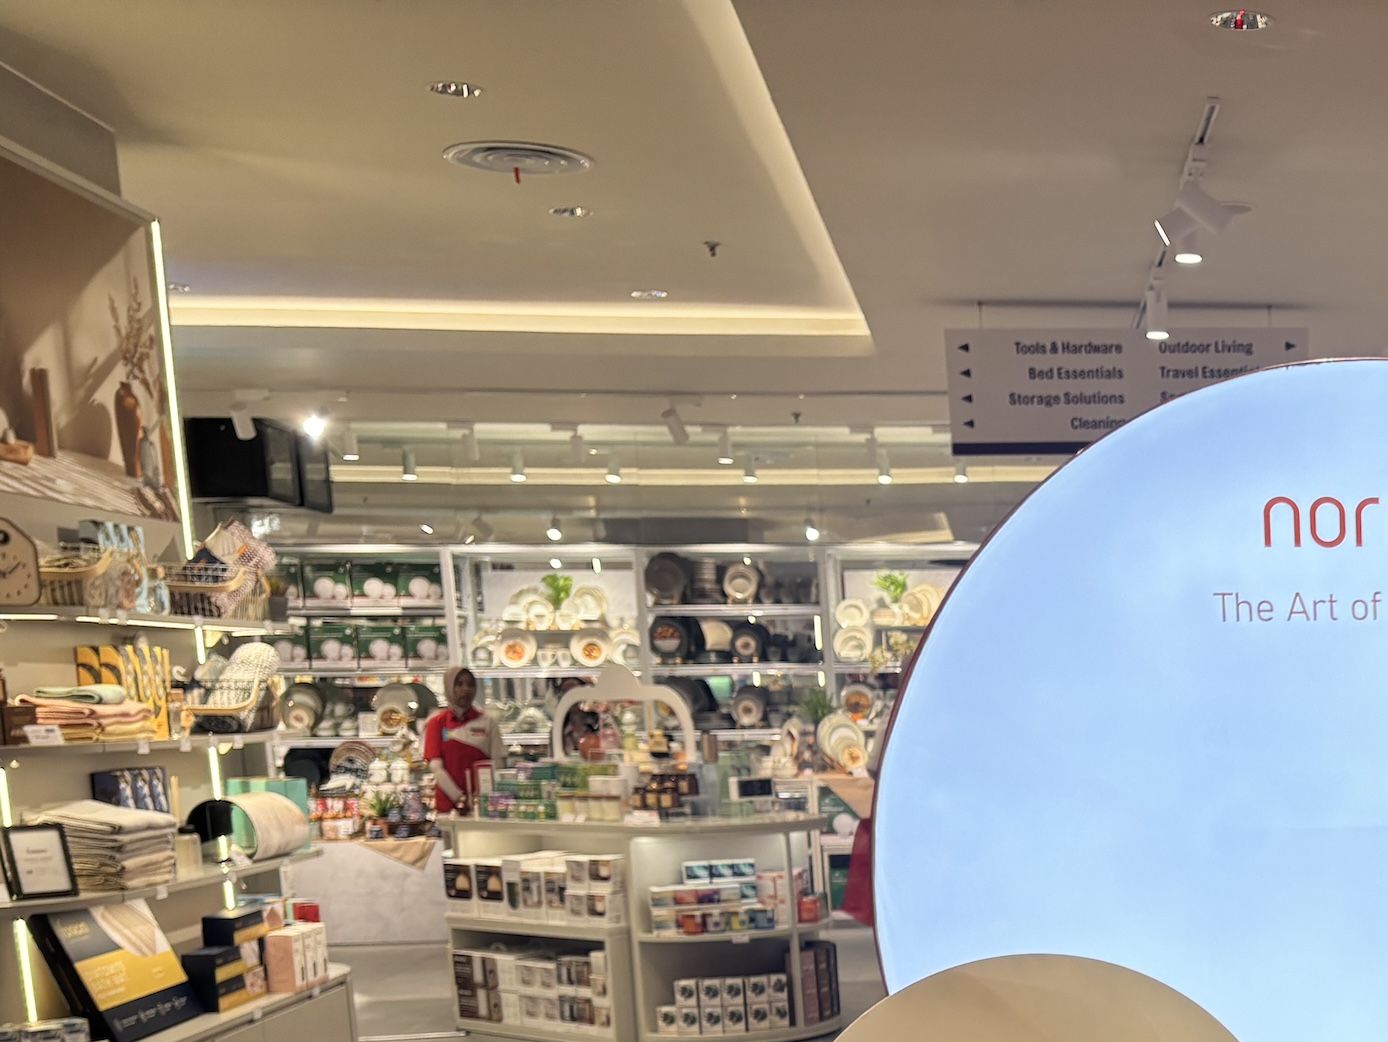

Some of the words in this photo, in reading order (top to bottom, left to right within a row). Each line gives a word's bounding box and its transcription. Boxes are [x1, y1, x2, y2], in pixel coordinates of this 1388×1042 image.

[1014, 342, 1046, 355] Tools
[1050, 342, 1059, 355] &
[1061, 341, 1122, 355] Hardware
[1159, 341, 1211, 355] Outdoor
[1214, 341, 1253, 356] Living
[1028, 366, 1053, 380] Bed
[1056, 366, 1124, 380] Essentials
[1159, 366, 1198, 379] Travel
[1009, 392, 1060, 407] Storage
[1063, 391, 1125, 405] Solutions
[1213, 592, 1274, 622] The
[1287, 592, 1338, 622] Art
[1352, 591, 1382, 621] of
